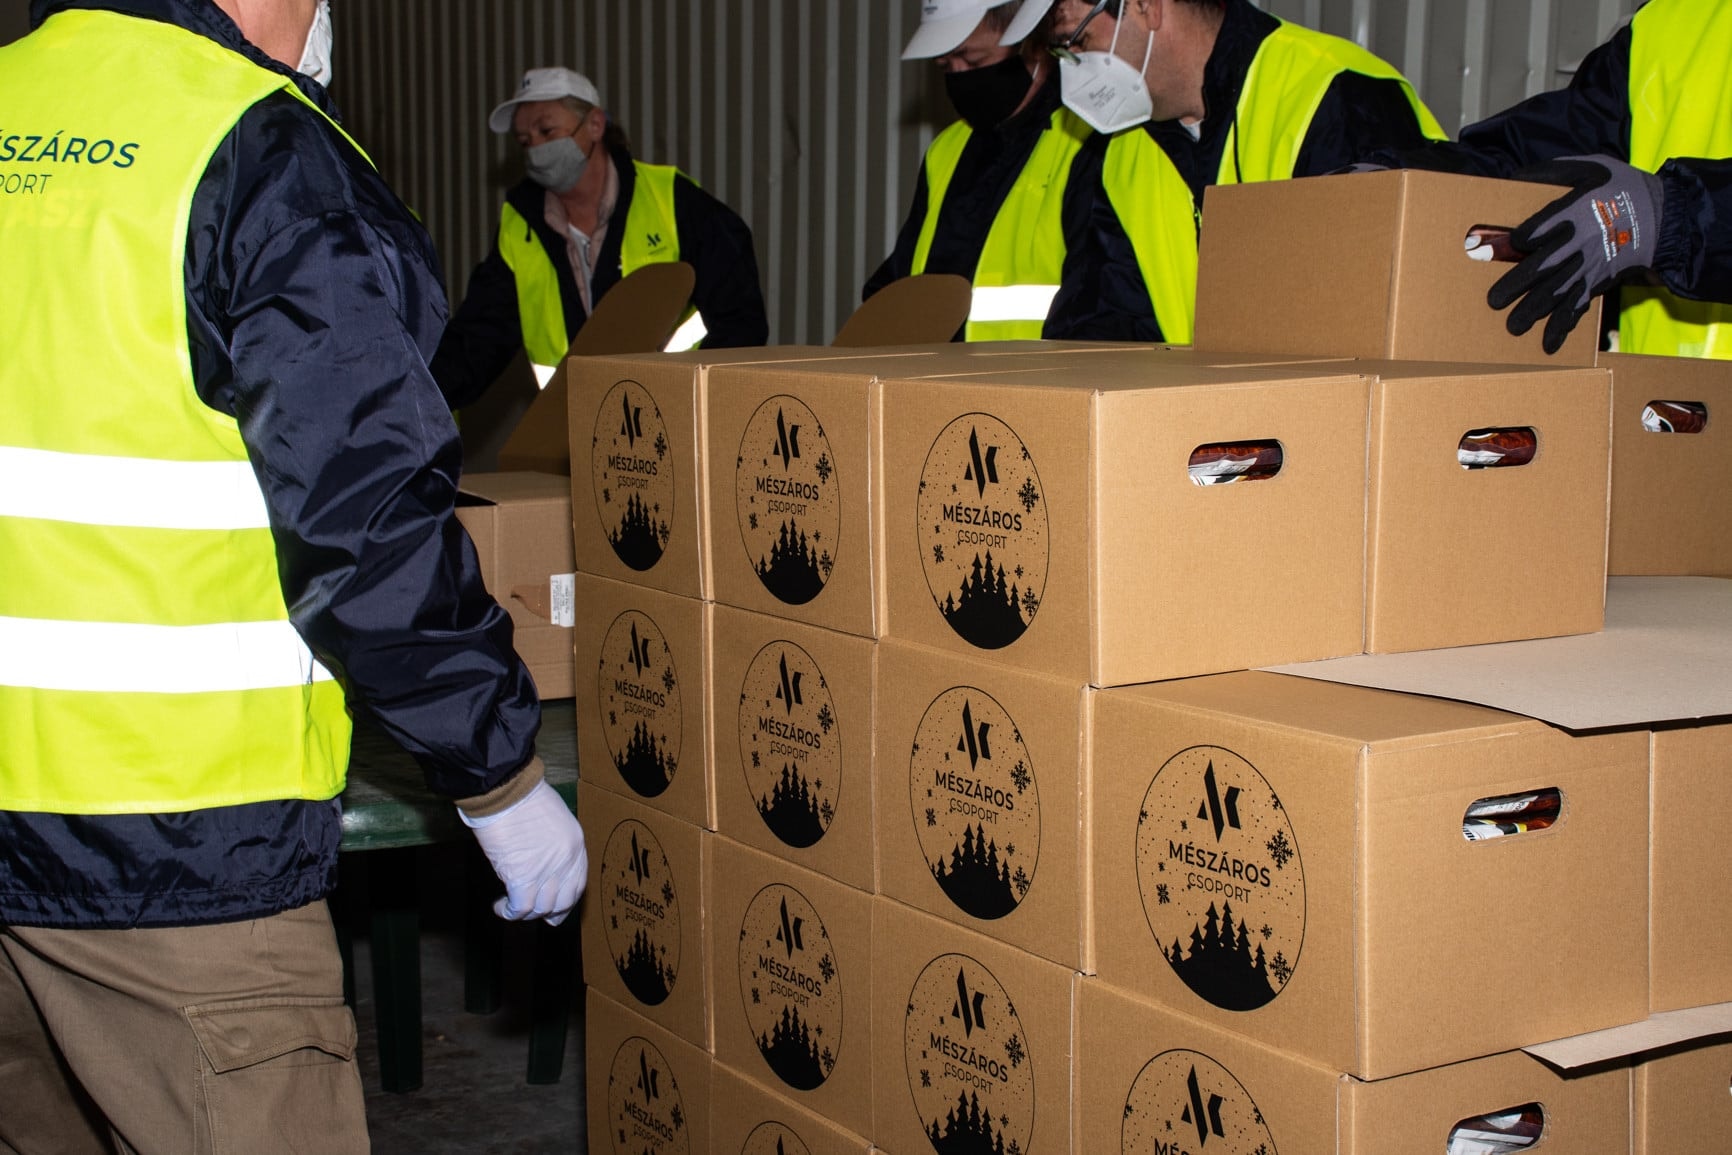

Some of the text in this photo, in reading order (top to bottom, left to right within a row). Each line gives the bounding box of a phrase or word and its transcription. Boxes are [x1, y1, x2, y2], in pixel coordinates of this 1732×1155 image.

[0, 129, 140, 168] SZÁROS
[608, 452, 658, 476] MÉSZÁROS
[617, 476, 649, 490] CSOPORT
[756, 474, 820, 501] MÉSZÁROS
[768, 500, 808, 517] CSOPORT
[942, 502, 1022, 532] MÉSZÁROS
[957, 529, 1008, 549] CSOPORT
[615, 679, 666, 708] MÉSZÁROS
[624, 700, 656, 721] CSOPORT
[758, 716, 821, 750] MÉSZÁROS
[770, 740, 810, 764] CSOPORT
[935, 769, 1014, 811] MÉSZÁROS
[949, 797, 999, 825] CSOPORT
[1169, 840, 1271, 888] MÉSZÁROS
[616, 884, 665, 920] MÉSZÁROS
[1187, 872, 1251, 903] CSOPORT
[625, 907, 656, 930] CSOPORT
[759, 954, 822, 997] MÉSZÁROS
[770, 981, 810, 1009] CSOPORT
[930, 1031, 1008, 1083] MÉSZÁROS
[944, 1062, 993, 1095] CSOPORT
[624, 1099, 674, 1142] MÉSZÁROS
